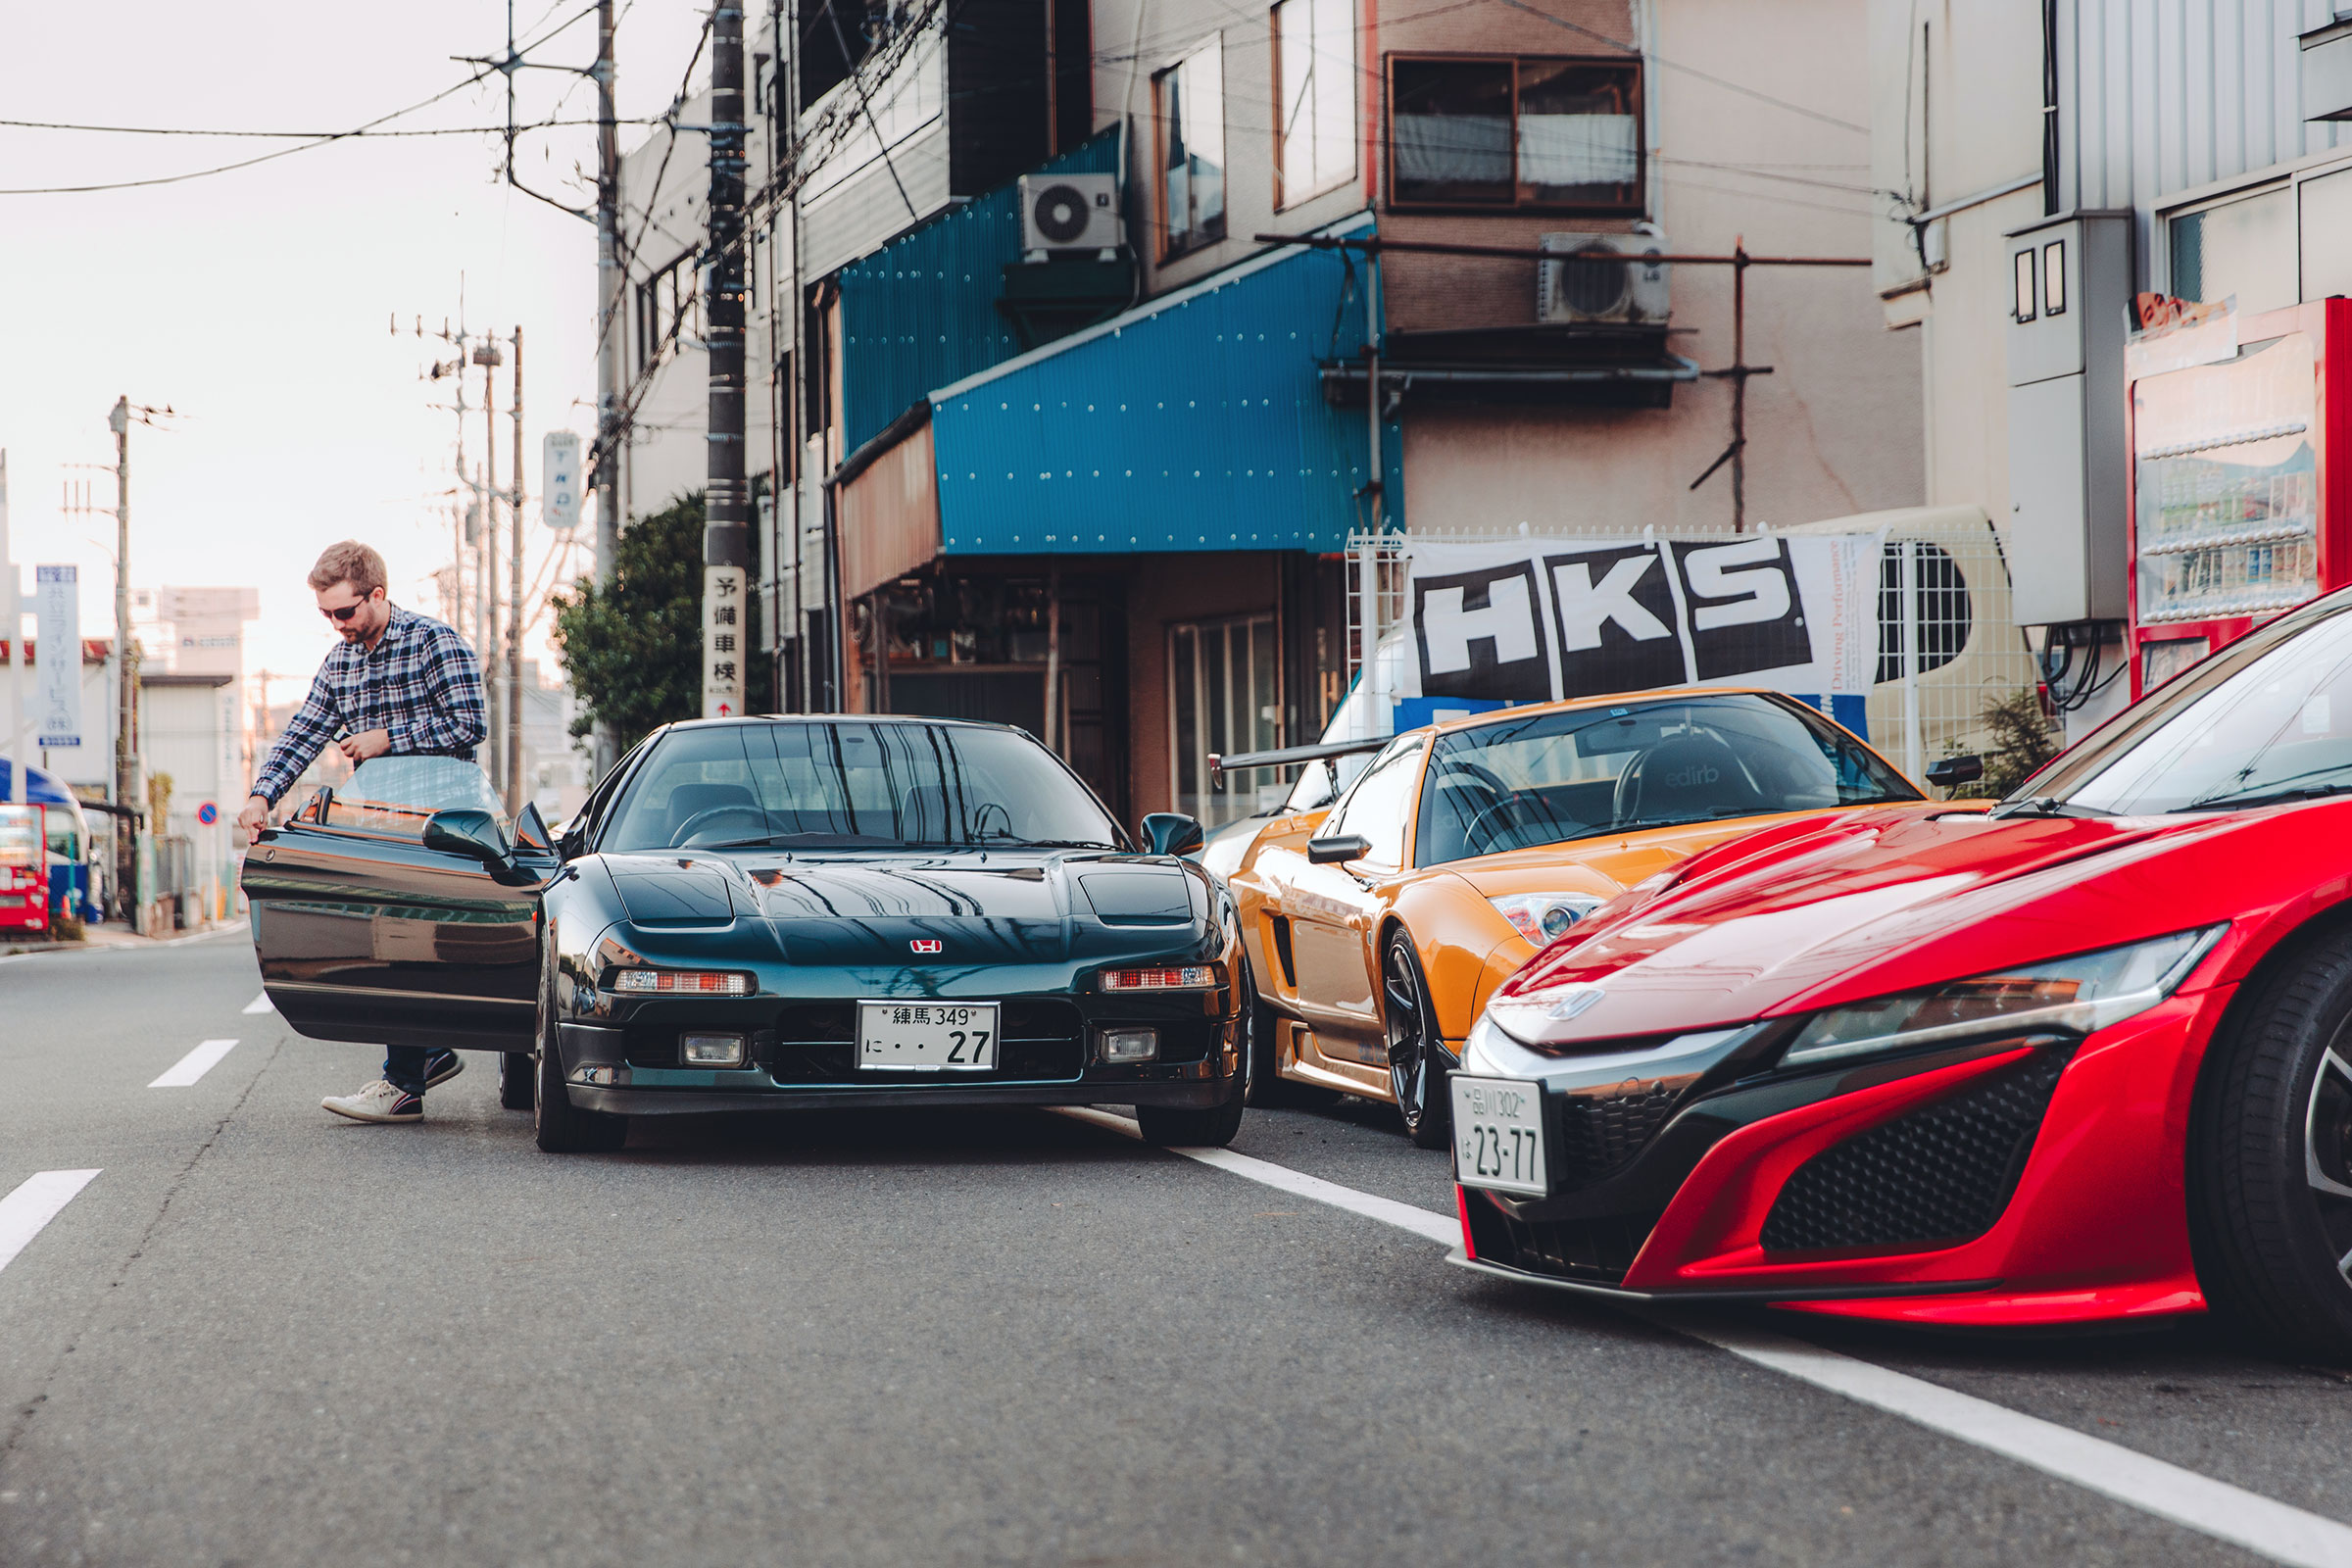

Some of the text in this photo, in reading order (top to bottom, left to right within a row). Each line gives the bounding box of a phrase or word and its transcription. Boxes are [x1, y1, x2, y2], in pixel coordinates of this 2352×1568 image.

[1424, 538, 1791, 675] HKS
[1830, 540, 1844, 690] Driving Performance
[713, 576, 737, 681] 予備車検
[1665, 764, 1720, 787] edirb
[893, 1006, 969, 1026] 練馬 349
[865, 1039, 883, 1054] に
[947, 1030, 991, 1064] 27
[1473, 1087, 1521, 1118] 品川 302
